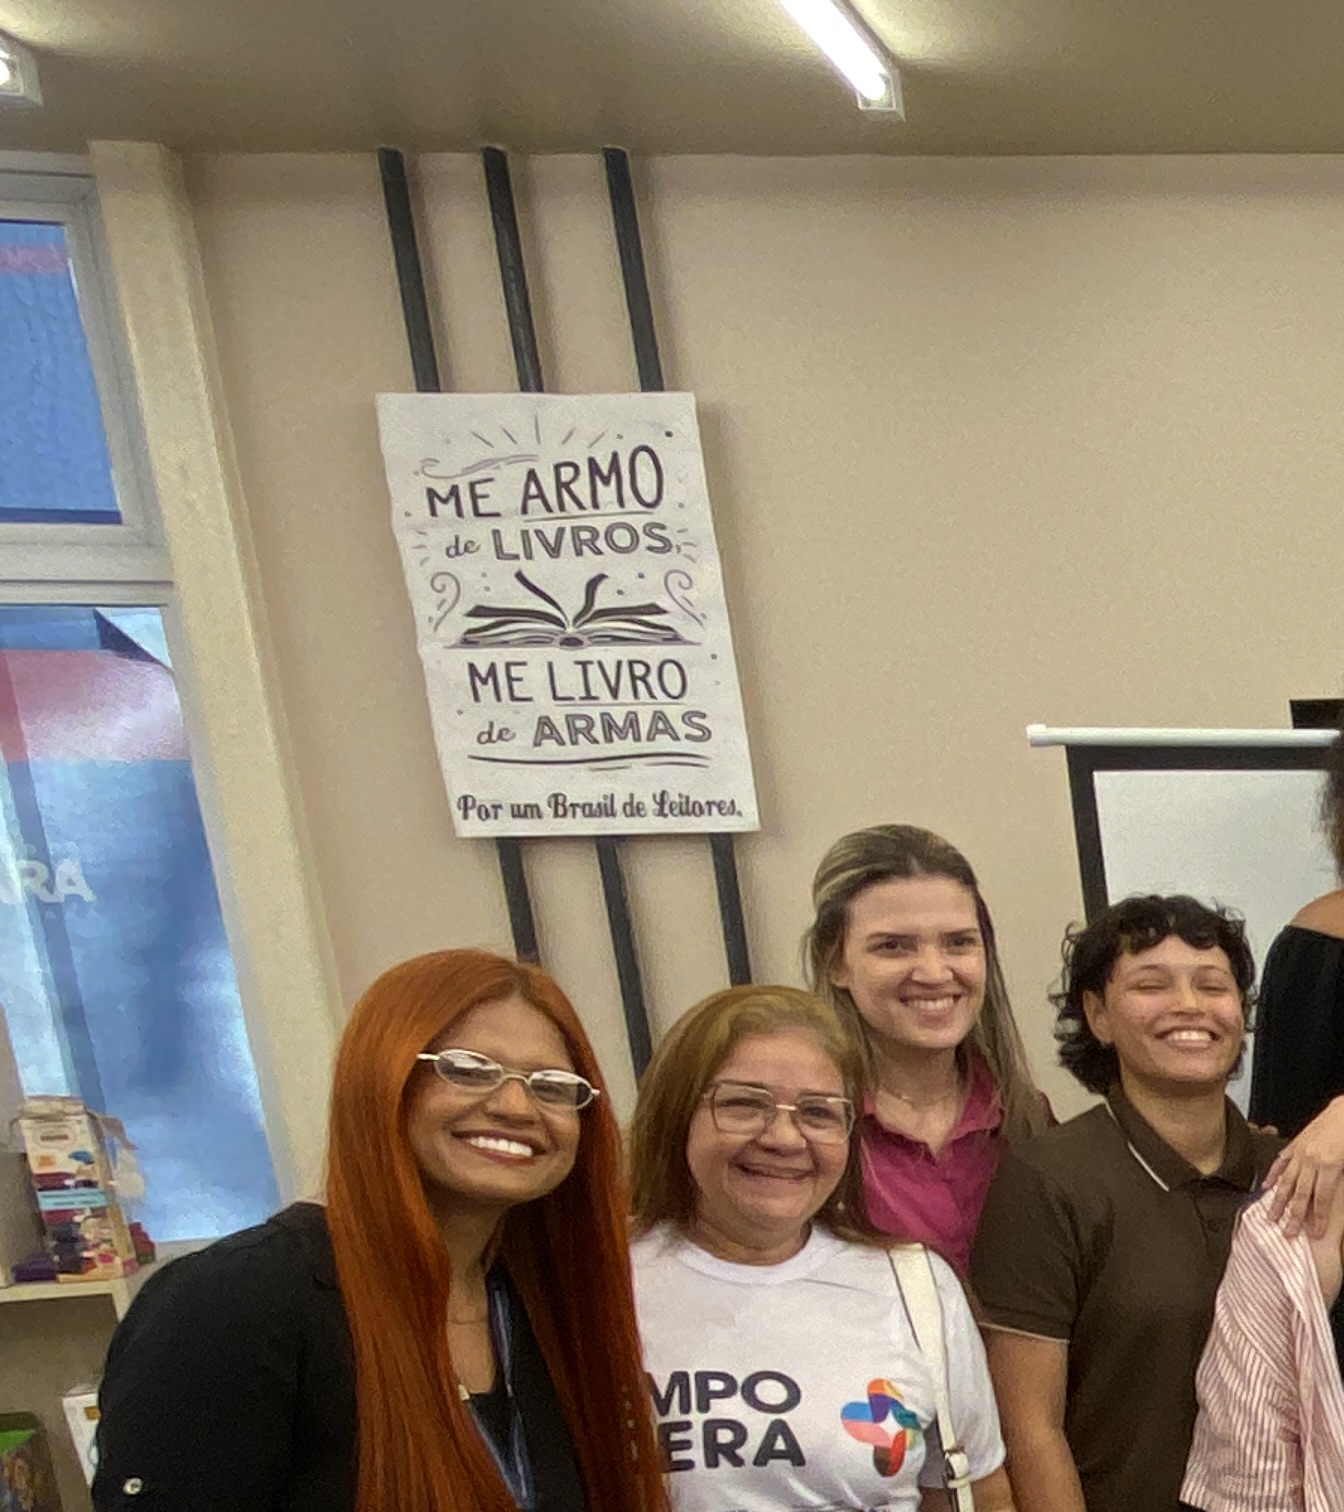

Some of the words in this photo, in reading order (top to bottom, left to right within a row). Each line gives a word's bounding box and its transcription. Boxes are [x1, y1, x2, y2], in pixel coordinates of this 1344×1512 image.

[425, 478, 501, 518] ME
[520, 445, 664, 515] ARMO
[445, 535, 481, 558] de
[467, 661, 534, 702] ME
[547, 659, 688, 701] LIVRO
[476, 721, 516, 745] de
[533, 711, 712, 747] ARMAS
[457, 794, 503, 821] Por
[510, 802, 543, 819] um
[548, 792, 617, 819] Brasil
[622, 793, 646, 818] de
[659, 1418, 806, 1473] ERA
